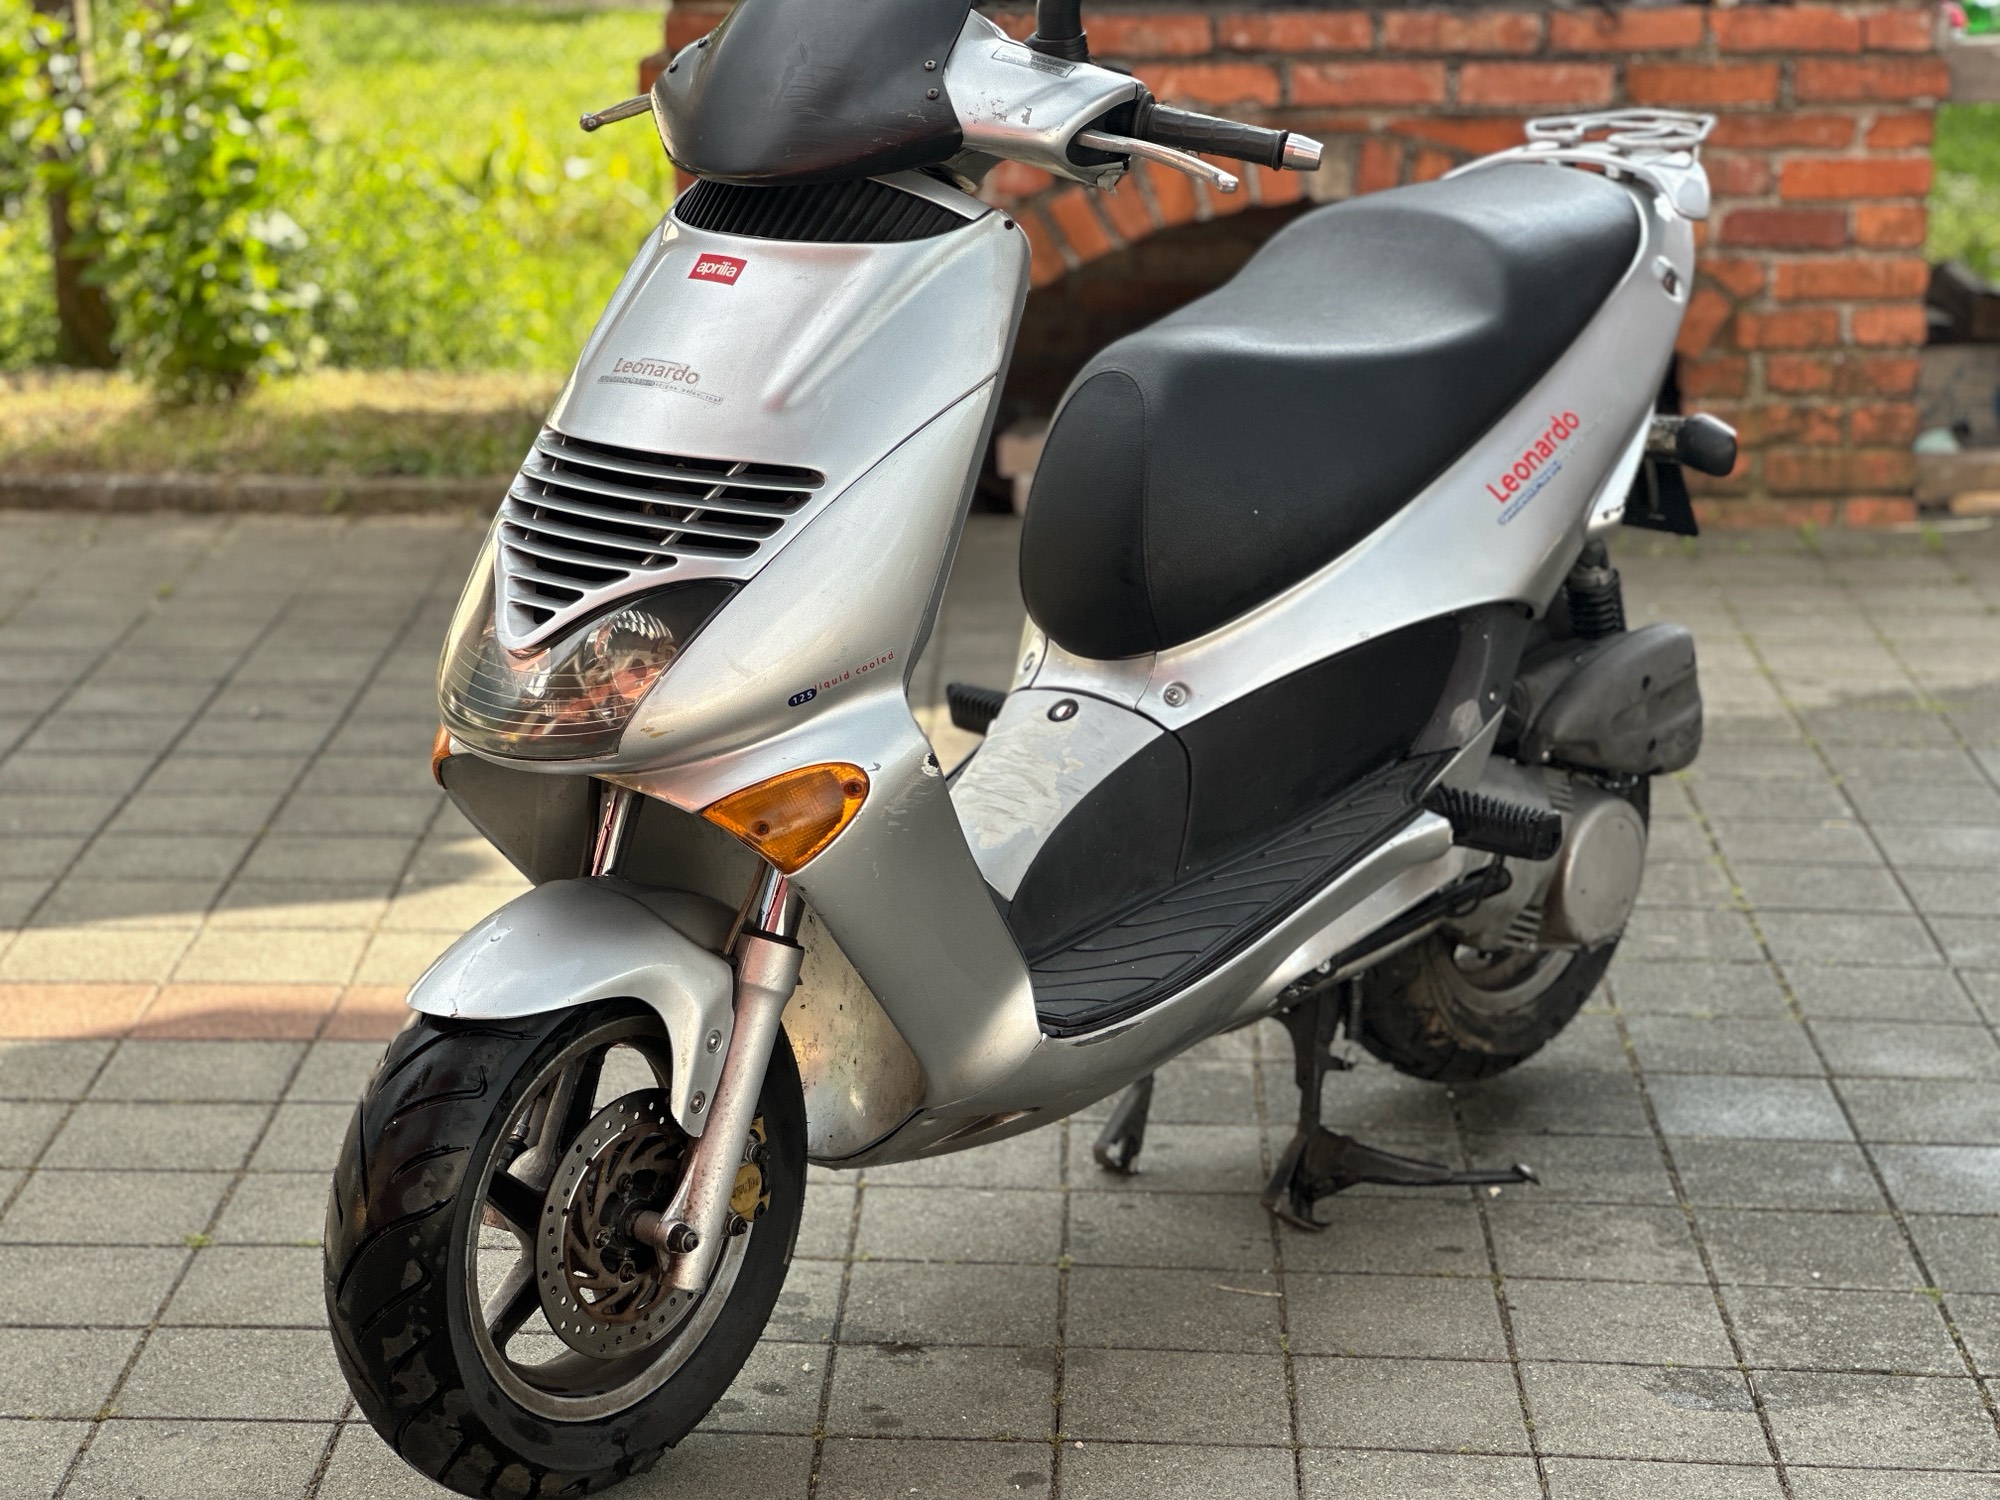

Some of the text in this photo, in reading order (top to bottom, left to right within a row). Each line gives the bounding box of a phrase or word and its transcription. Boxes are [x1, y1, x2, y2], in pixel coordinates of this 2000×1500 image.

[696, 261, 738, 278] aprilia
[613, 357, 700, 385] Leonardo
[1485, 410, 1580, 504] Leonardo
[793, 651, 895, 704] 125 liquid cooled
